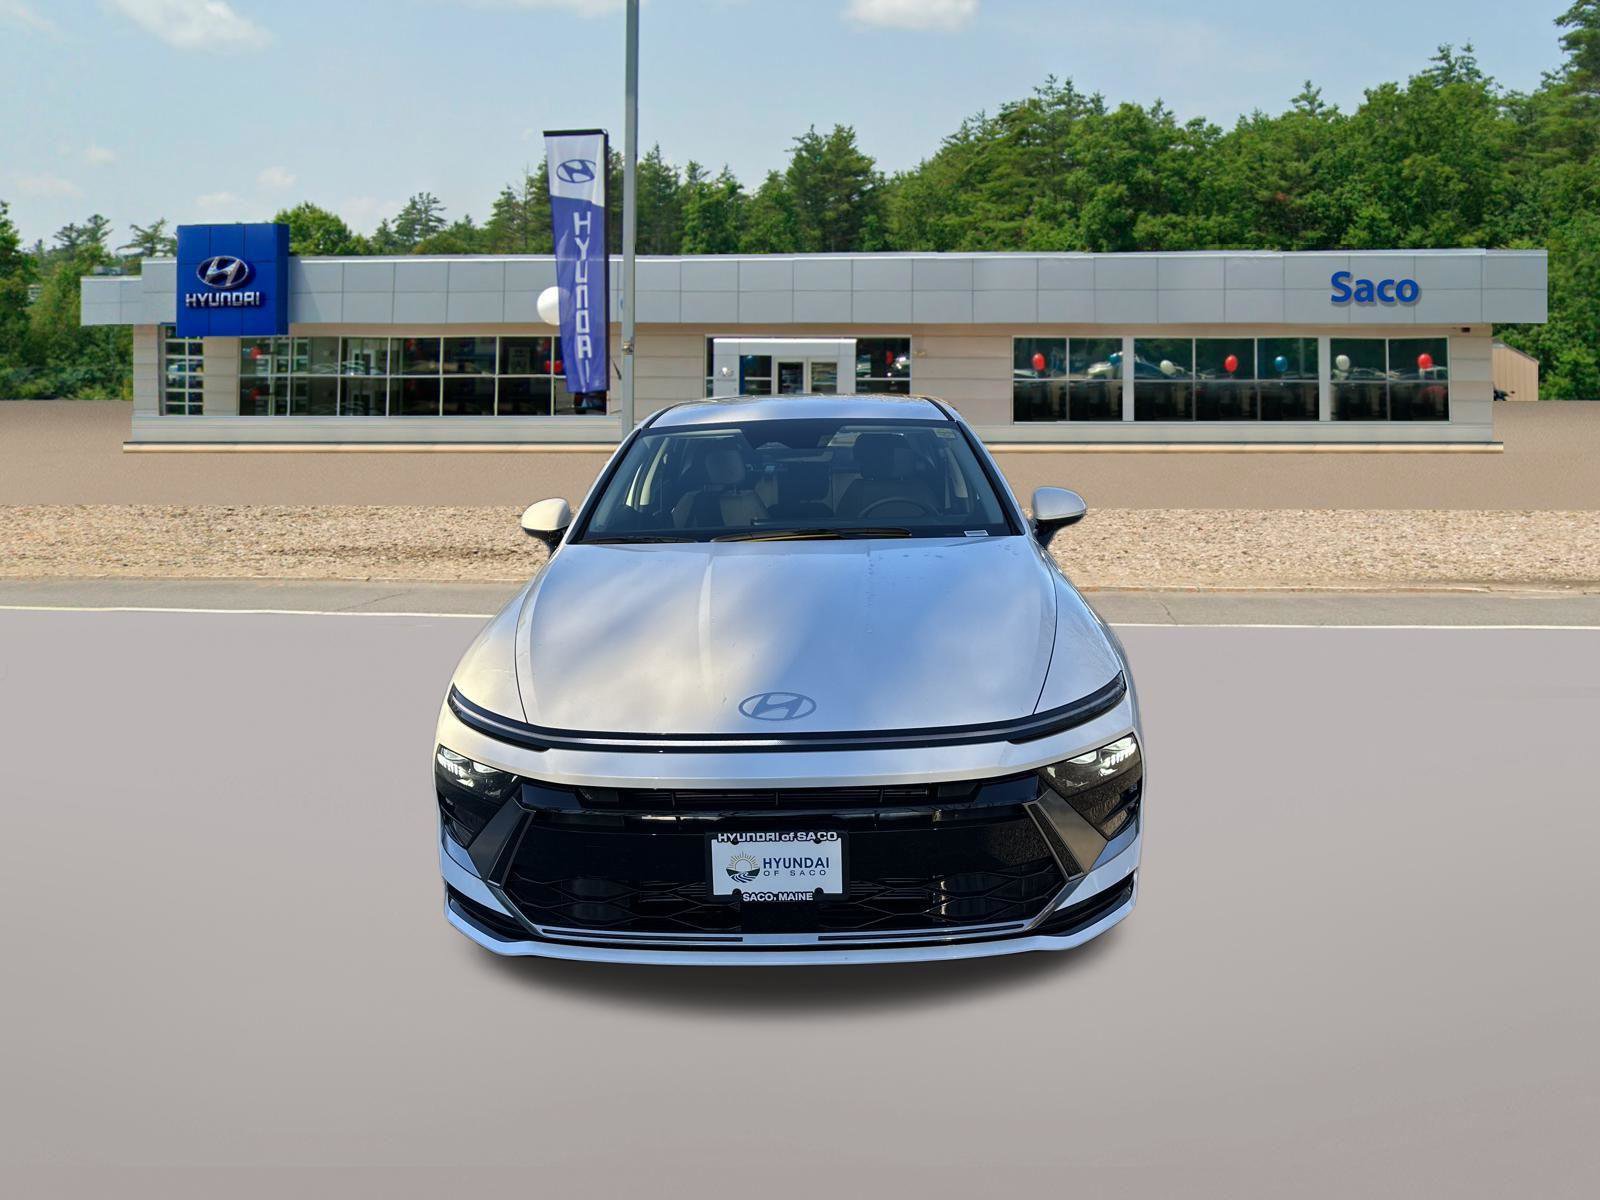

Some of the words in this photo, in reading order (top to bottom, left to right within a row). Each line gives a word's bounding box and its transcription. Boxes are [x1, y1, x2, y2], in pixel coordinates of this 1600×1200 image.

[1331, 271, 1419, 303] Saco
[185, 292, 260, 308] HYUNDAI
[573, 211, 592, 384] HYUNDAI
[718, 833, 779, 842] HYUNDAI
[781, 833, 795, 841] of
[797, 832, 838, 841] SACO
[763, 857, 830, 869] HYUNDAI
[742, 893, 777, 902] SACO,
[778, 893, 813, 901] MAINE
